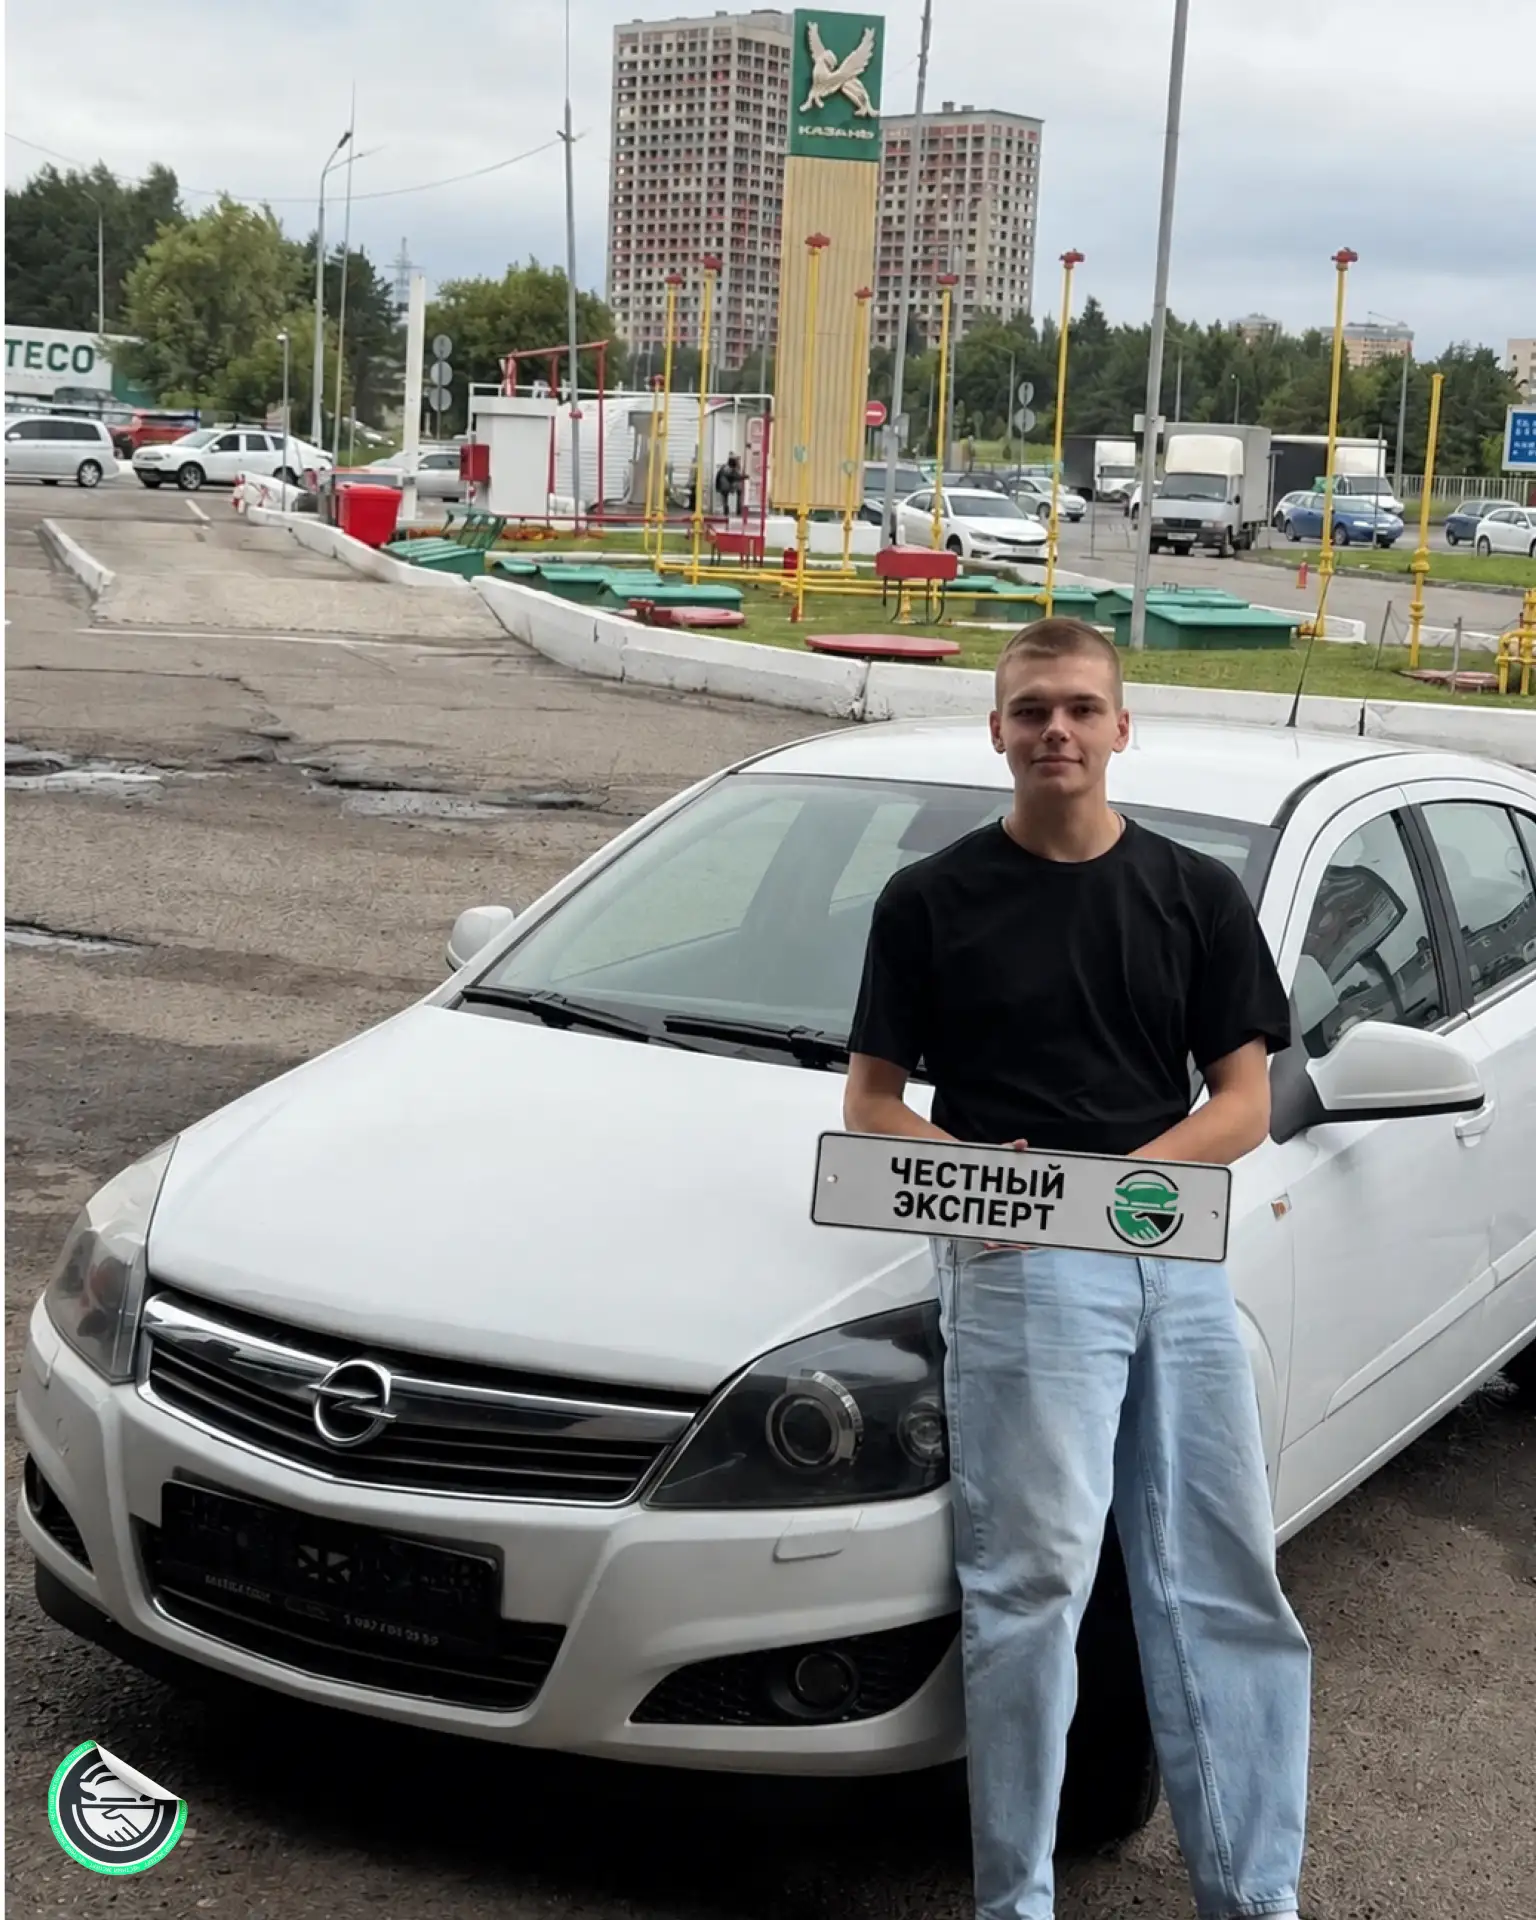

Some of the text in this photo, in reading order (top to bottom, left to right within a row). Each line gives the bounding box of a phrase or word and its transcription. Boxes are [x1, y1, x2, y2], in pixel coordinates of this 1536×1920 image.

[798, 125, 875, 139] КАЗАНЬ
[890, 1157, 1065, 1199] ЧЕСТНЫЙ
[893, 1190, 1055, 1230] ЭКСПЕРТ
